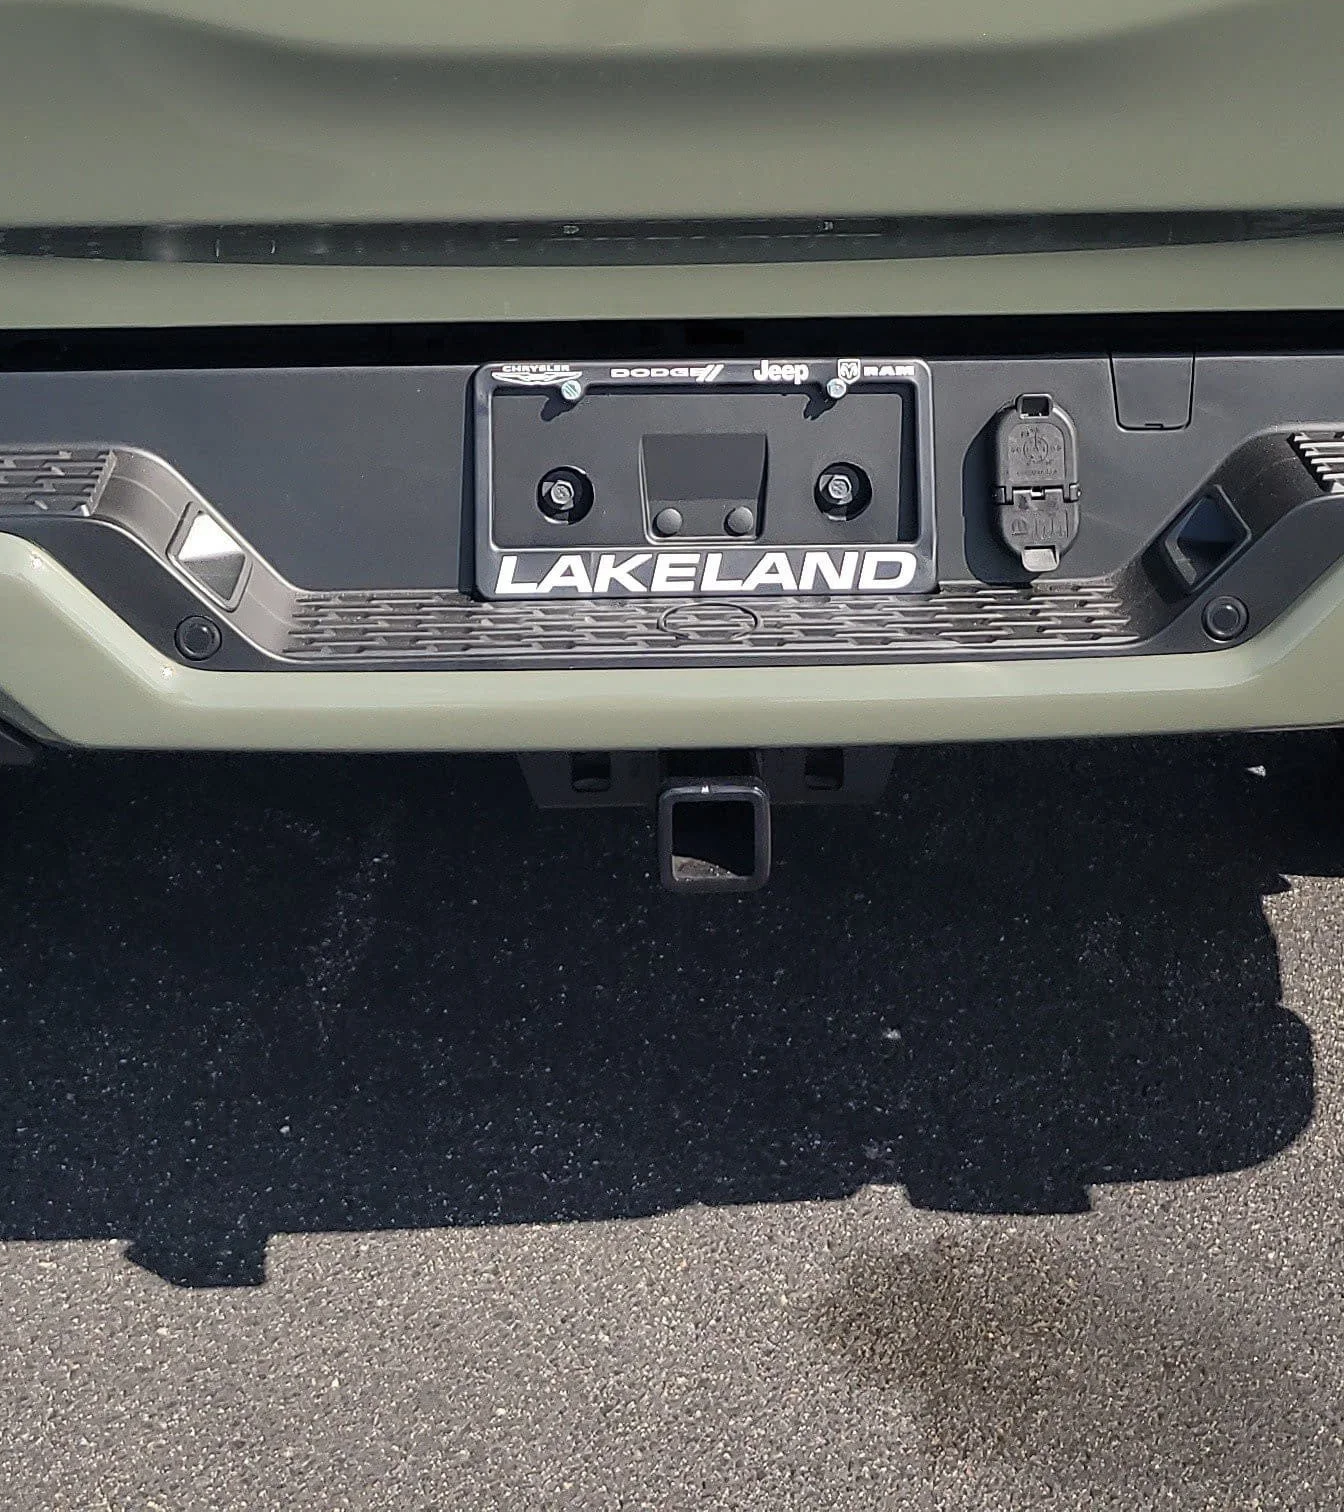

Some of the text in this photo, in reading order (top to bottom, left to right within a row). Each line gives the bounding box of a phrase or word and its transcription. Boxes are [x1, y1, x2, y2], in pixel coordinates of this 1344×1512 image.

[502, 360, 915, 384] CHRYSLER DODGE Jeep RAM
[495, 551, 917, 593] LAKELAND
